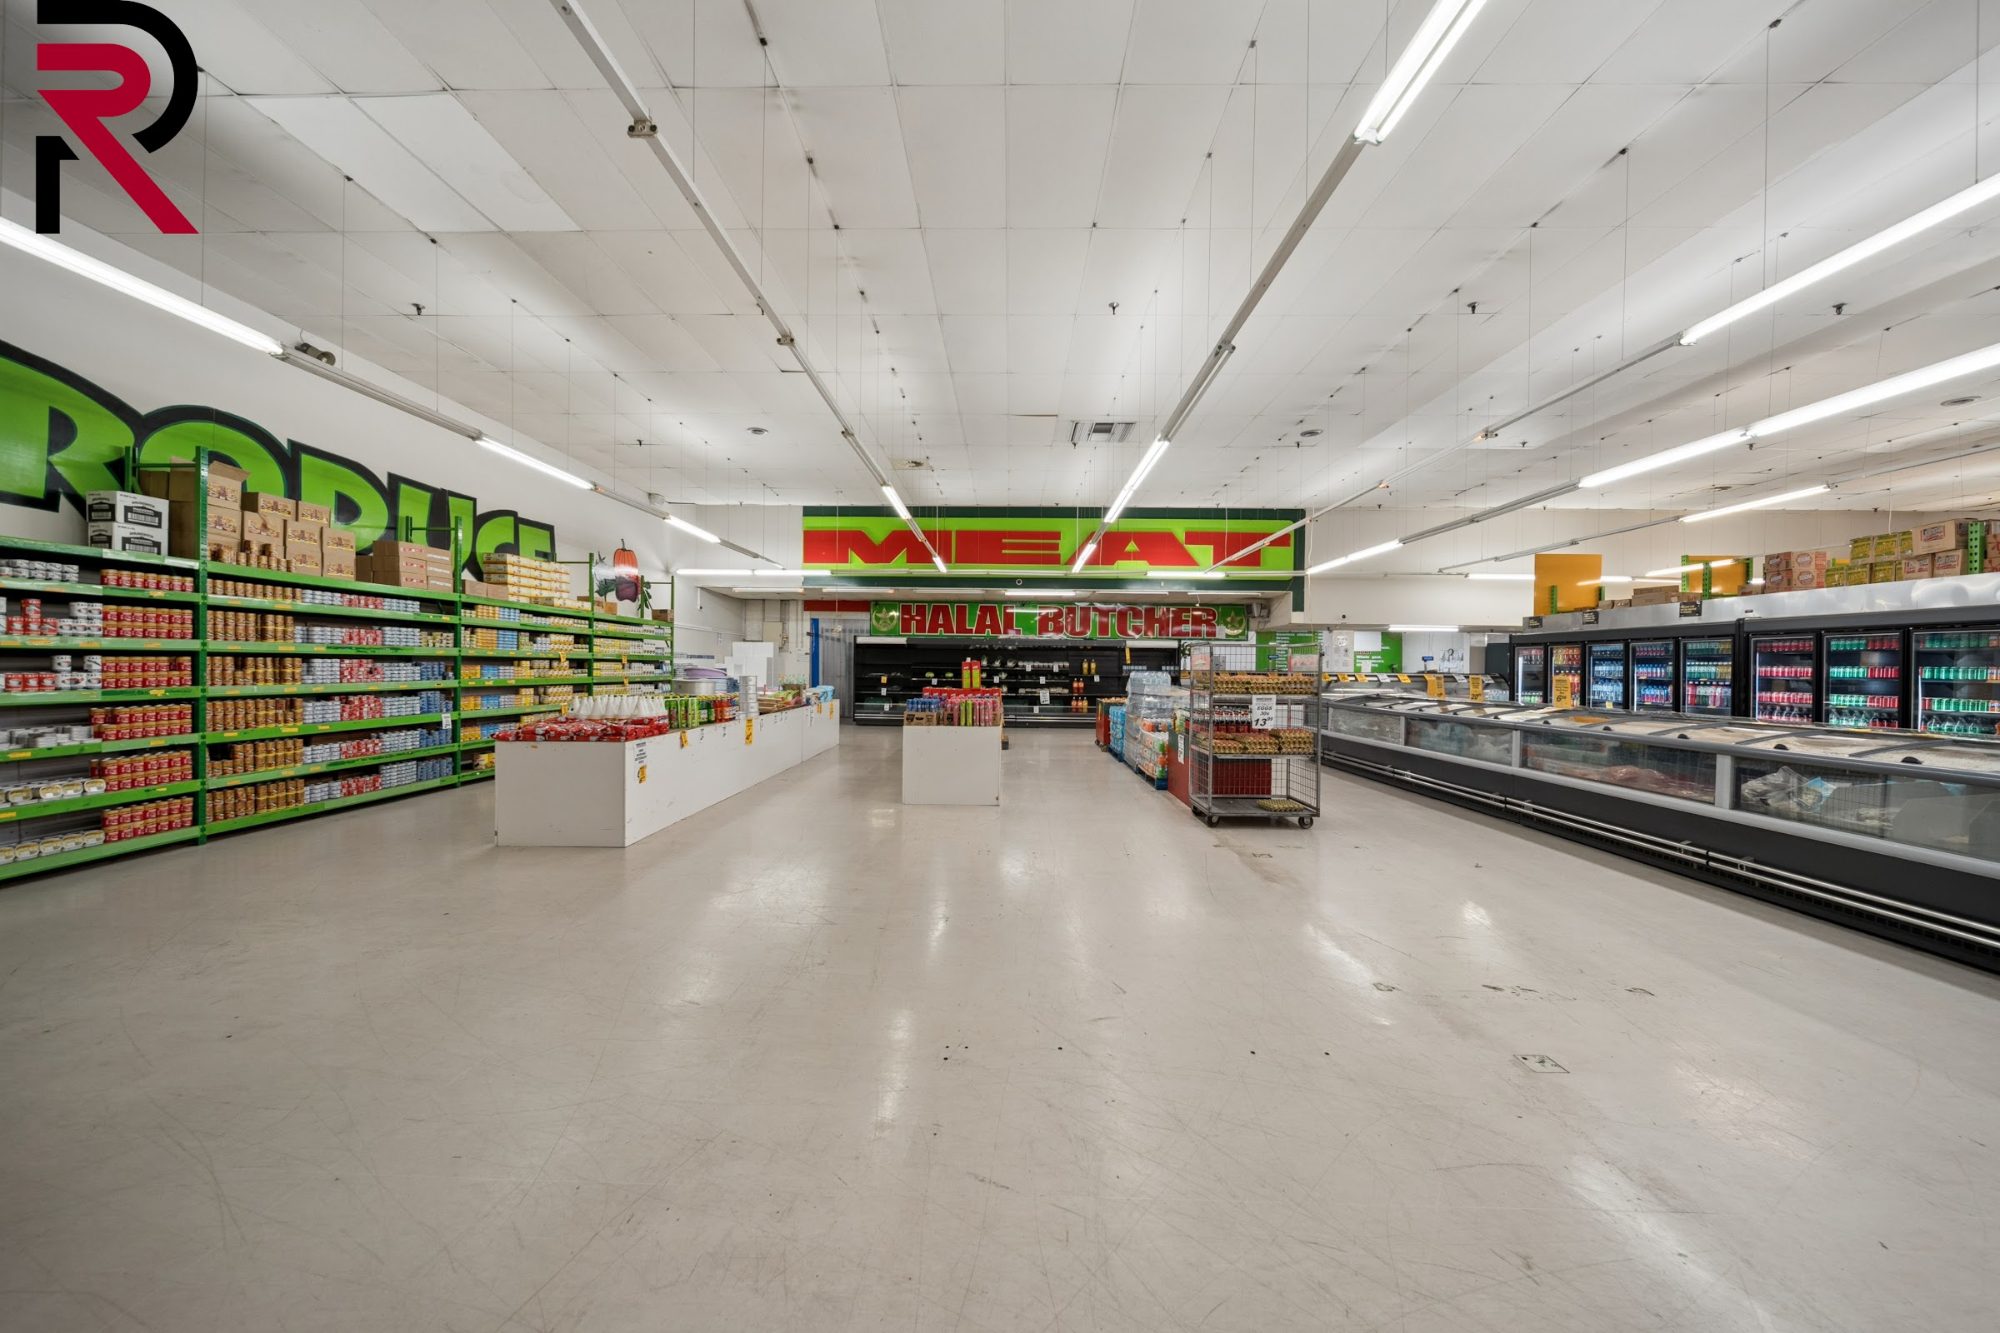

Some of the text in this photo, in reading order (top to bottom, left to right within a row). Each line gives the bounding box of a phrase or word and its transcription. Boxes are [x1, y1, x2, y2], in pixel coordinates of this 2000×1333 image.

[803, 529, 1291, 567] MEAT
[899, 603, 1218, 638] HALAL BUTCHER
